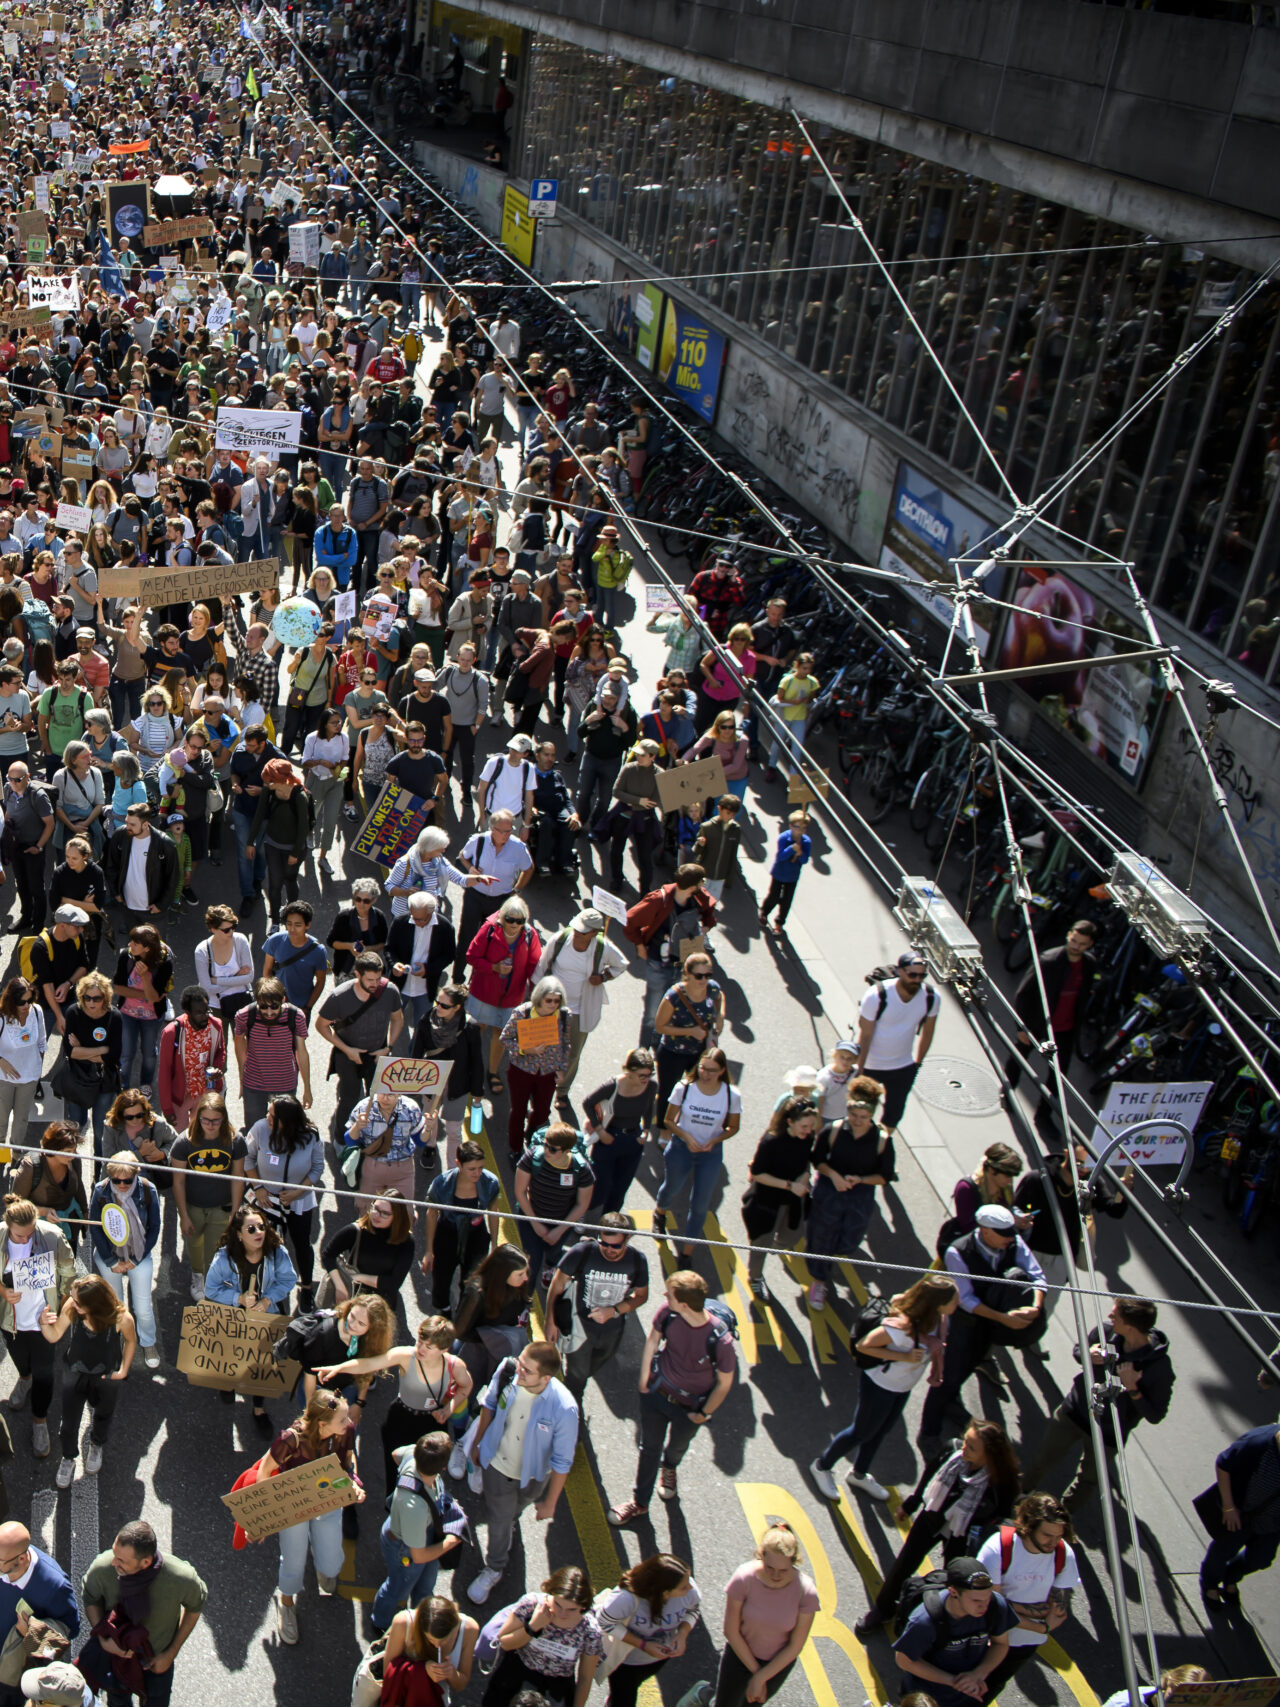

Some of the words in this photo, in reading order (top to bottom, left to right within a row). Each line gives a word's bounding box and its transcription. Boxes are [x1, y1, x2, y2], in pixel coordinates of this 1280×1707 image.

[536, 182, 552, 199] P
[31, 278, 59, 288] MAKE
[31, 292, 52, 302] NOT
[681, 339, 707, 367] 110
[676, 365, 701, 390] Mio.
[899, 493, 949, 545] DECATHLON
[187, 570, 209, 586] LES
[214, 560, 273, 579] GLACIERS
[174, 589, 189, 602] DE
[191, 586, 206, 599] LA
[357, 825, 379, 854] PLUS
[381, 826, 402, 856] PLUS
[400, 809, 415, 827] ON
[389, 1067, 434, 1083] HELL
[1119, 1093, 1147, 1104] THE
[1134, 1135, 1158, 1145] OUR
[1159, 1134, 1185, 1145] TURN
[1118, 1150, 1154, 1161] NOW
[226, 1308, 248, 1322] DIE
[188, 1334, 225, 1356] UND
[194, 1353, 239, 1376] SIND
[250, 1364, 287, 1384] WIR
[228, 1487, 269, 1508] WÄRE
[271, 1475, 295, 1491] DAS
[297, 1463, 336, 1482] KLIMA
[241, 1498, 278, 1515] EINE
[280, 1485, 311, 1504] BANK
[291, 1498, 312, 1512] IHR
[317, 1487, 337, 1499] ES
